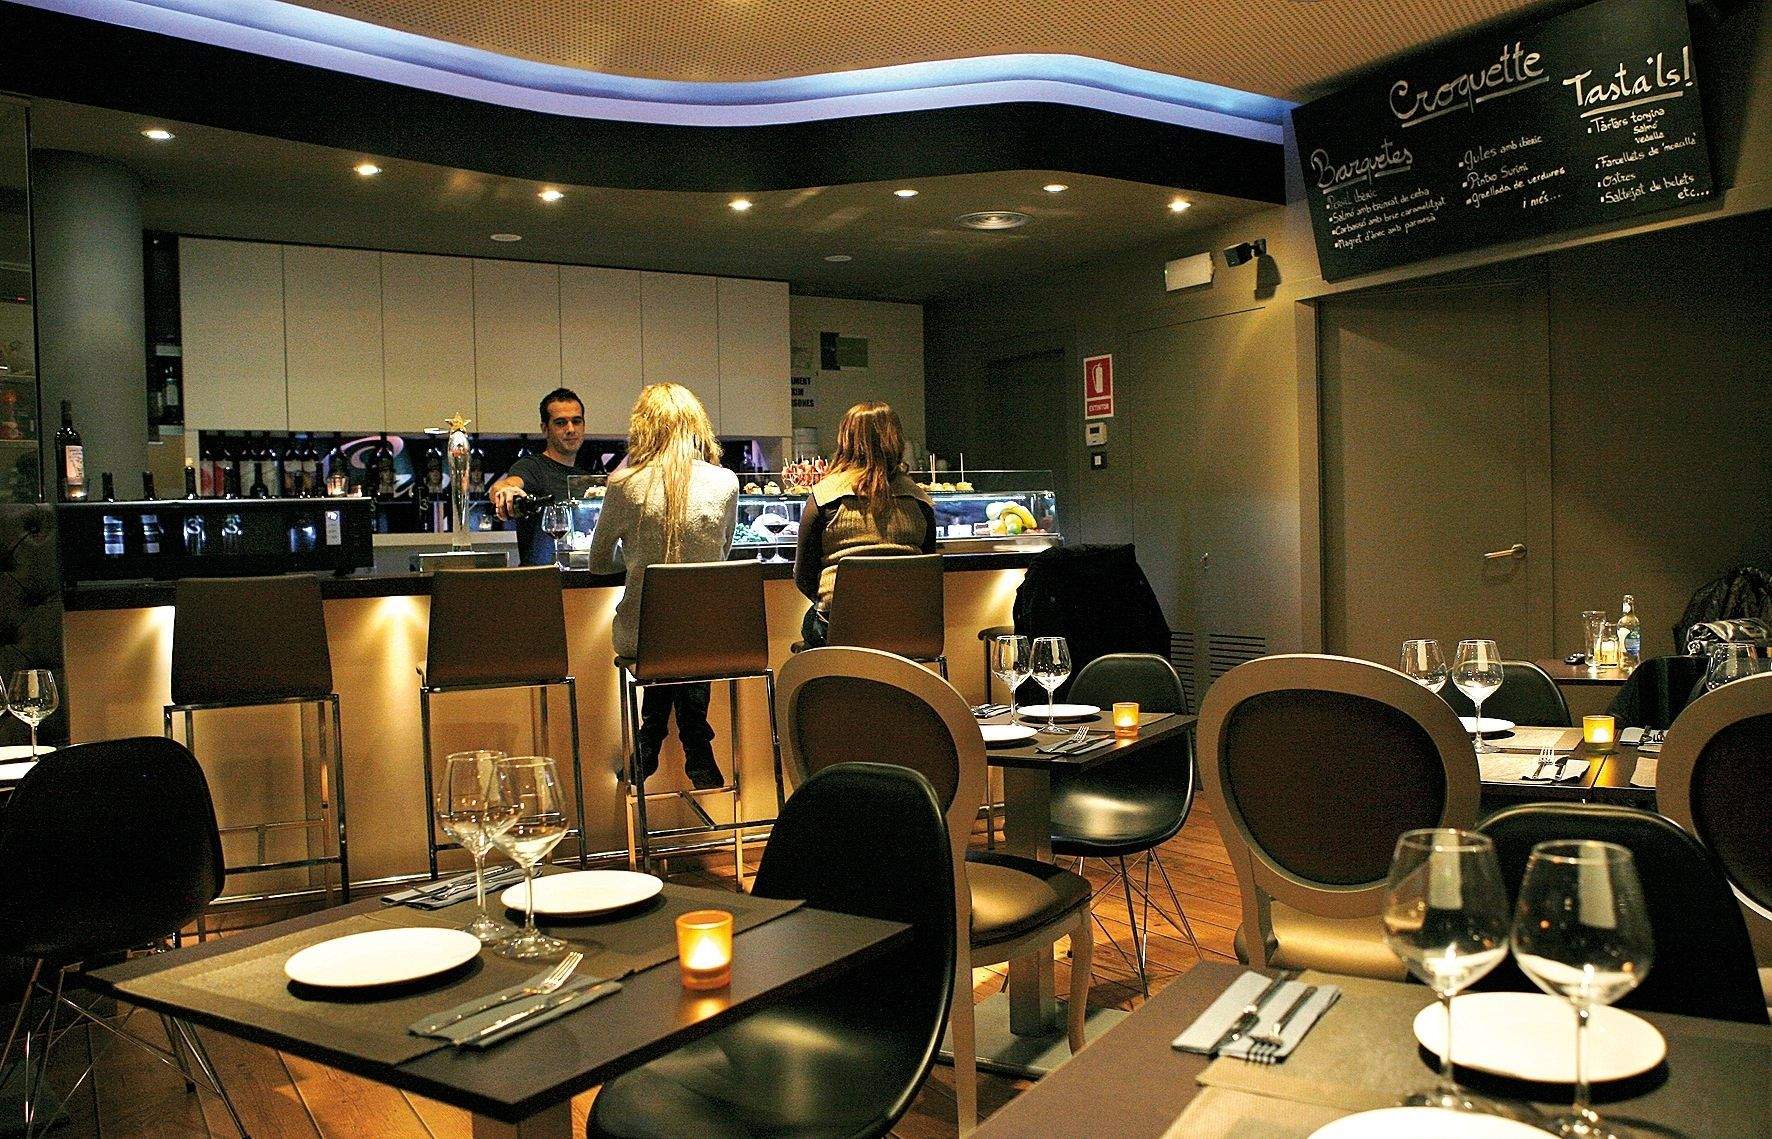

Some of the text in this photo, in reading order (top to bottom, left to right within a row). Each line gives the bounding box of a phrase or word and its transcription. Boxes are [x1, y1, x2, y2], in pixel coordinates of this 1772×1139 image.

[1389, 41, 1544, 119] Croquette
[1562, 45, 1694, 107] Tasta'ls!
[1630, 108, 1665, 122] tonyina
[1500, 141, 1518, 154] amb
[1648, 147, 1659, 156] de
[1310, 138, 1413, 188] Barquetes
[1500, 162, 1529, 178] Surimi
[1513, 180, 1525, 190] de
[1527, 166, 1565, 185] verdures
[1602, 171, 1636, 187] Ostres
[1649, 180, 1662, 192] de
[1356, 204, 1372, 216] amb
[1400, 194, 1409, 203] de
[1410, 187, 1430, 200] ceba
[1368, 216, 1382, 226] amb
